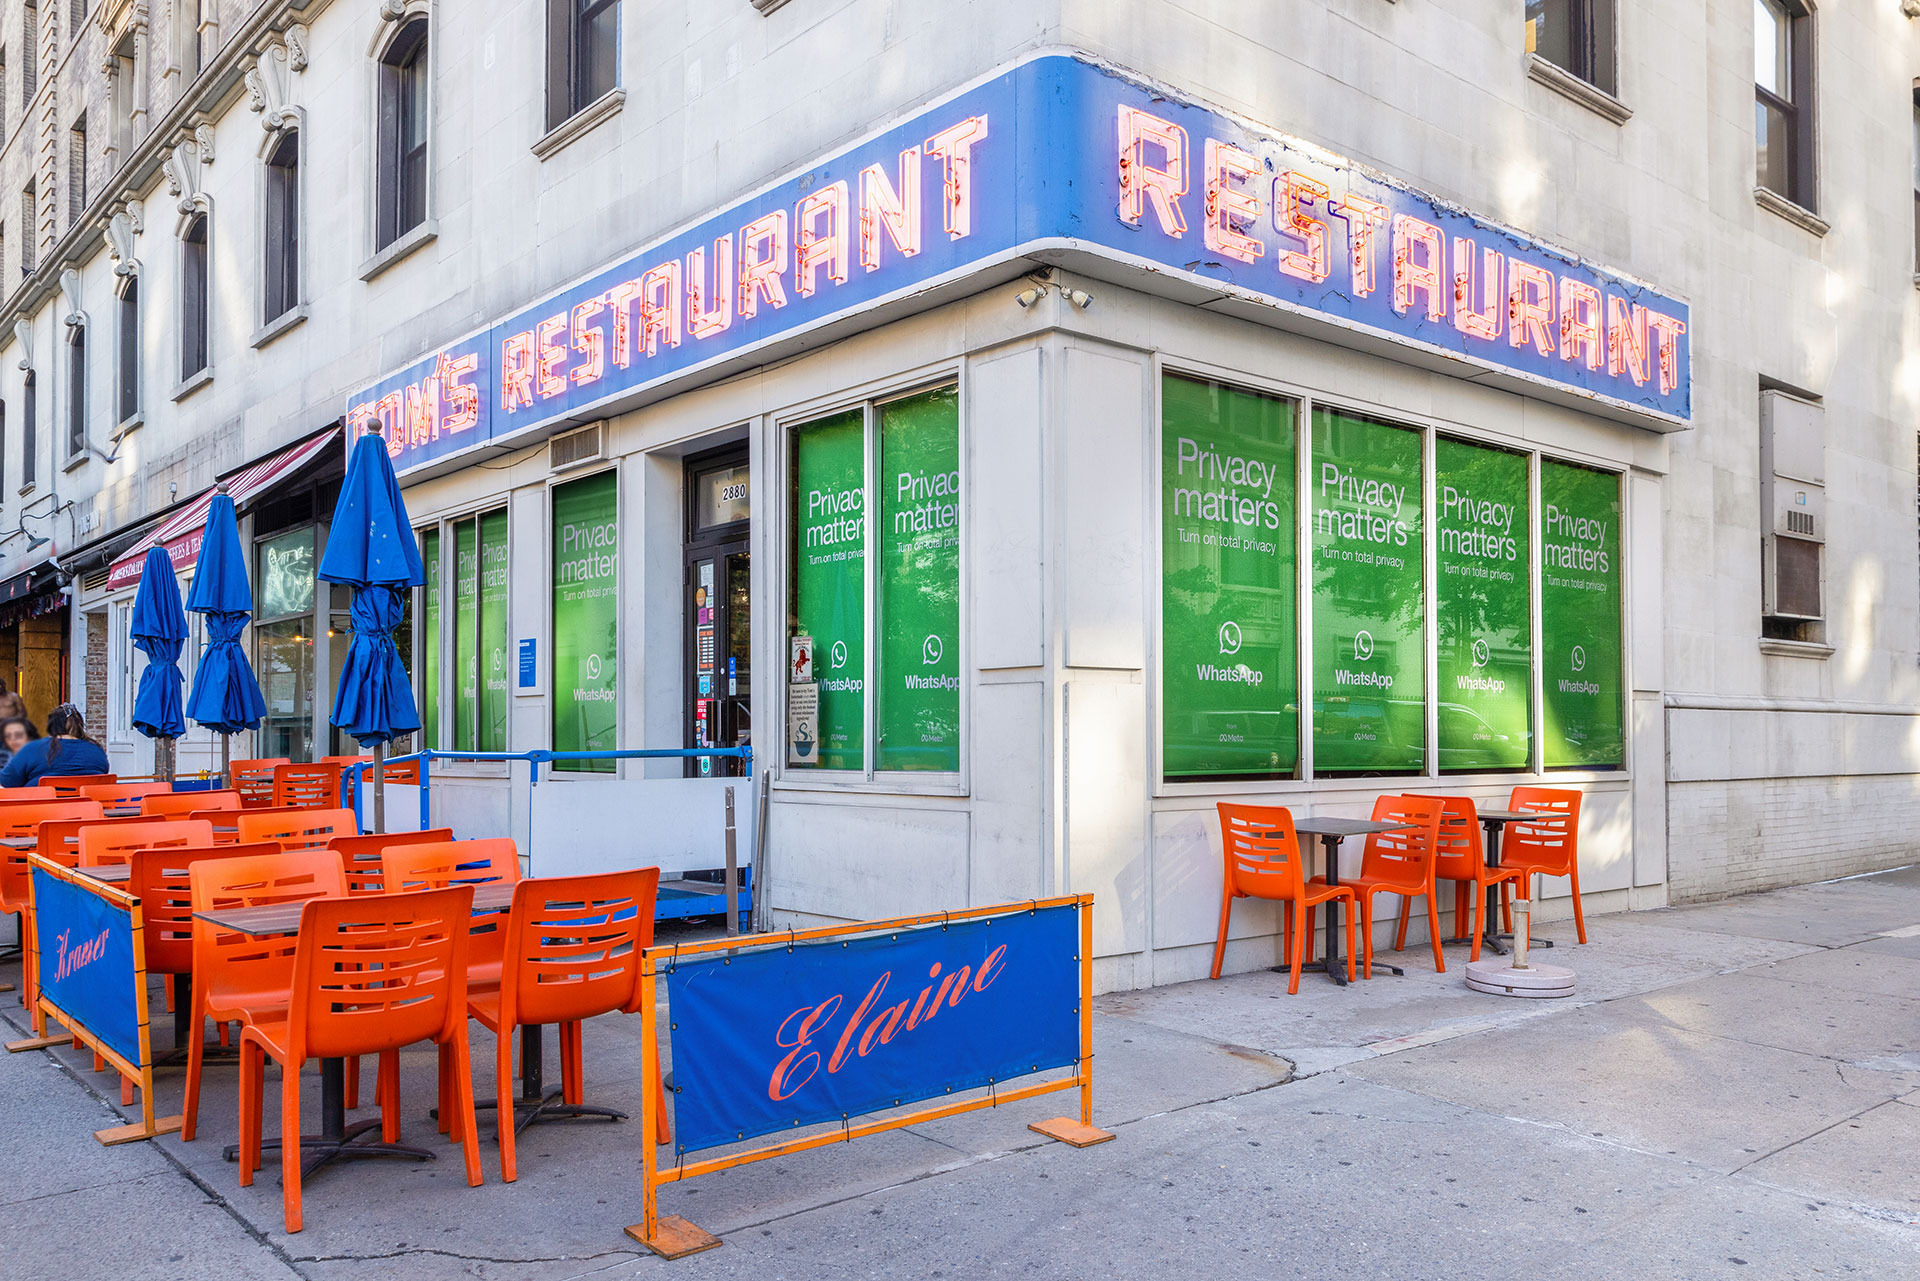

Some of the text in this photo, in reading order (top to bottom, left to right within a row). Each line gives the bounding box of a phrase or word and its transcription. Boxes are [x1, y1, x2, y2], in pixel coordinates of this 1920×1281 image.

[500, 113, 988, 412] RESTAURANT
[1117, 103, 1686, 396] RESTAURANT
[1178, 437, 1276, 499] Privacy
[723, 484, 745, 501] 2880
[1322, 462, 1405, 517] Privacy
[1174, 487, 1279, 530] matters
[1443, 486, 1514, 535] Privacy
[563, 521, 617, 553] Privac
[807, 516, 864, 548] matter
[1318, 508, 1407, 546] matters
[1546, 504, 1607, 549] Privacy
[897, 542, 912, 553] Turn
[914, 541, 923, 551] on
[1177, 528, 1277, 556] Turn on total privacy
[1441, 526, 1516, 561] matters
[808, 554, 822, 565] Turn
[823, 554, 831, 563] on
[832, 549, 847, 561] total
[1321, 545, 1405, 571] Turn on total privacy
[1545, 542, 1609, 573] matters
[1443, 561, 1514, 584] Turn on total privacy
[1546, 574, 1607, 594] Turn on total privacy
[905, 674, 959, 692] WhatsApp
[1196, 664, 1263, 686] WhatsApp
[1335, 670, 1393, 689] WhatsApp
[1457, 675, 1505, 693] WhatsApp
[1558, 679, 1599, 696] WhatsApp
[573, 687, 615, 703] WhatsApp
[1227, 733, 1243, 742] Meta
[1361, 733, 1376, 741] Meta
[768, 944, 1007, 1101] Elaine
